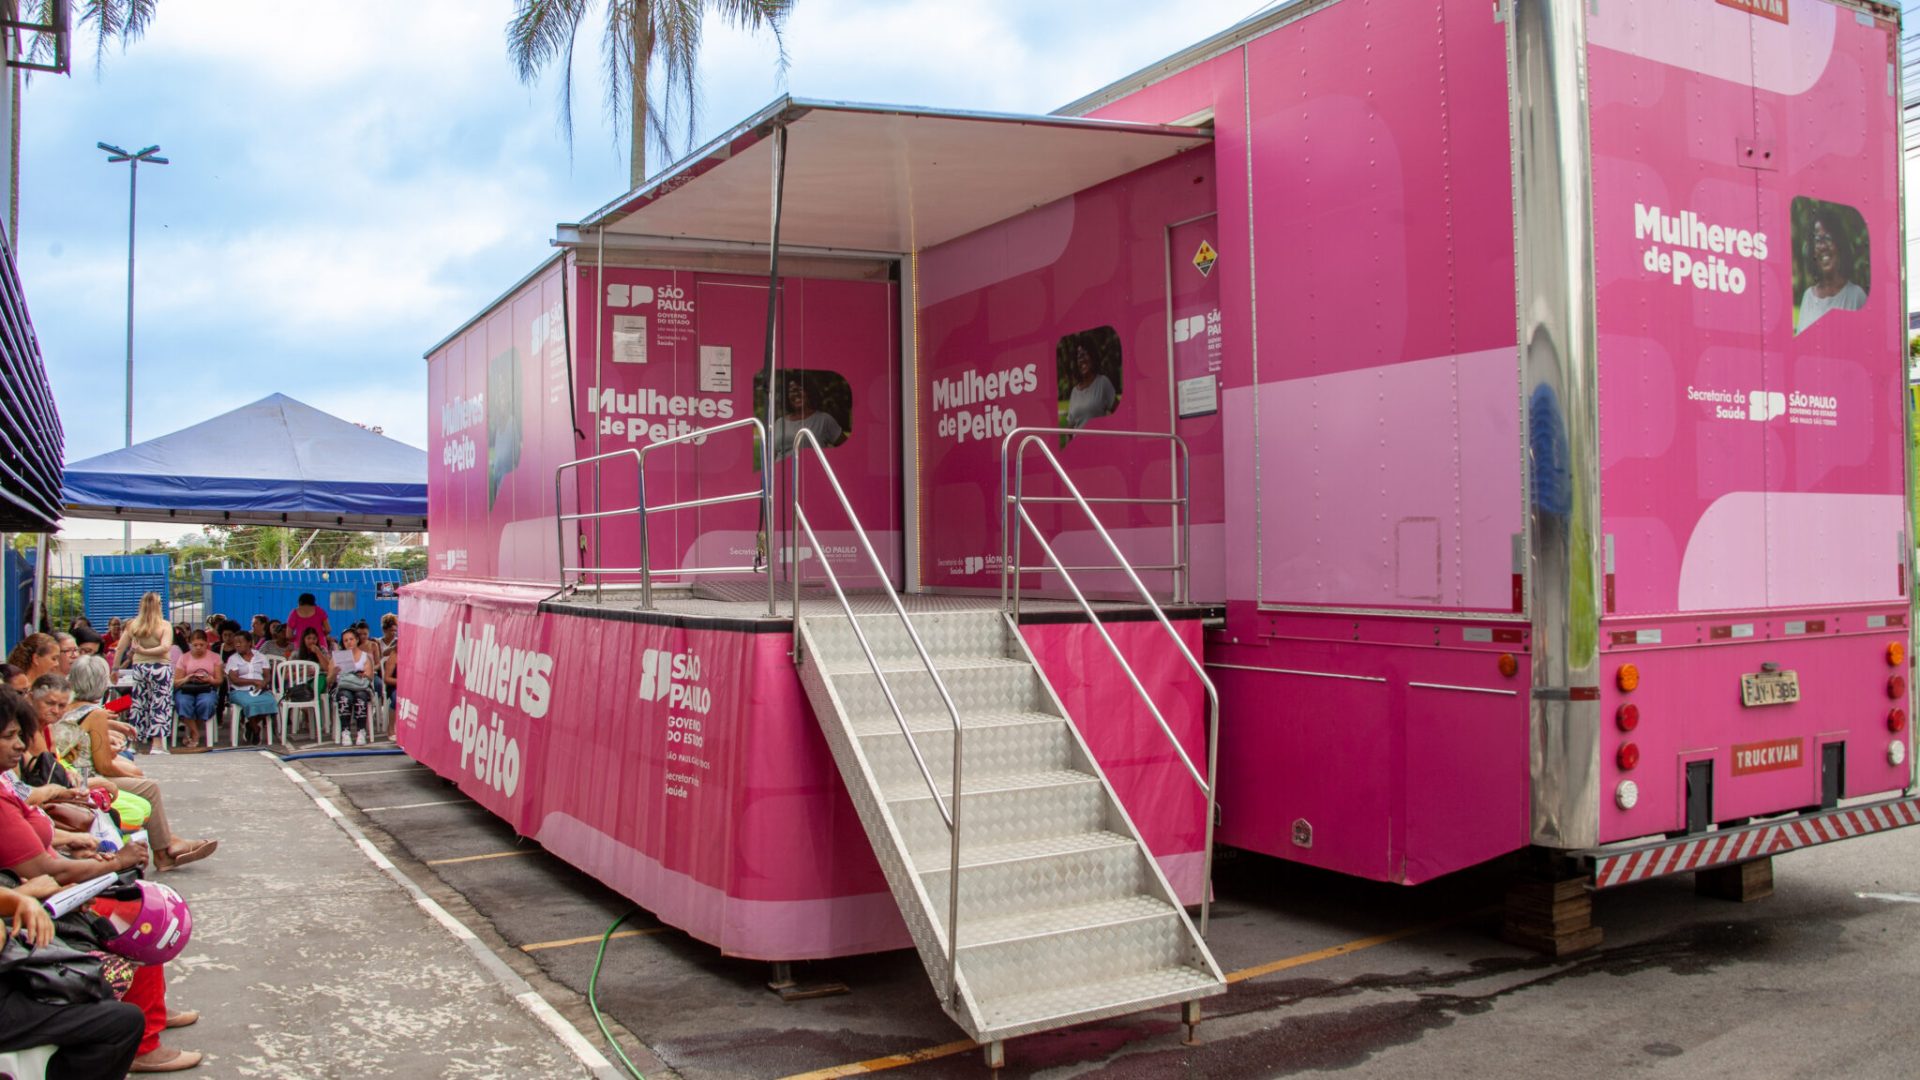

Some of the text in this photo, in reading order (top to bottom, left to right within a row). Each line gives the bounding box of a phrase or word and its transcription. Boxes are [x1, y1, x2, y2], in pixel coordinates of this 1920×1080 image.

[1634, 202, 1769, 260] Mulheres
[1644, 246, 1746, 294] de Peito
[657, 285, 684, 299] SÃO
[657, 312, 687, 320] GOVERNO
[587, 387, 734, 419] Mulheres
[932, 363, 1038, 412] Mulheres
[1687, 385, 1746, 404] Secretaria da
[1789, 391, 1837, 410] SÃO PAULO
[441, 393, 484, 438] Mulheres
[938, 404, 1017, 443] de Peito
[1716, 405, 1746, 420] Saúde
[600, 416, 708, 446] de Peito
[443, 434, 476, 473] de Peito
[833, 546, 857, 554] PAULO
[449, 621, 553, 719] Mulheres
[671, 648, 701, 682] SÃO
[668, 683, 711, 715] PAULO
[461, 704, 520, 799] Peito
[667, 730, 681, 743] DO
[1736, 743, 1799, 769] TRUCKVAN
